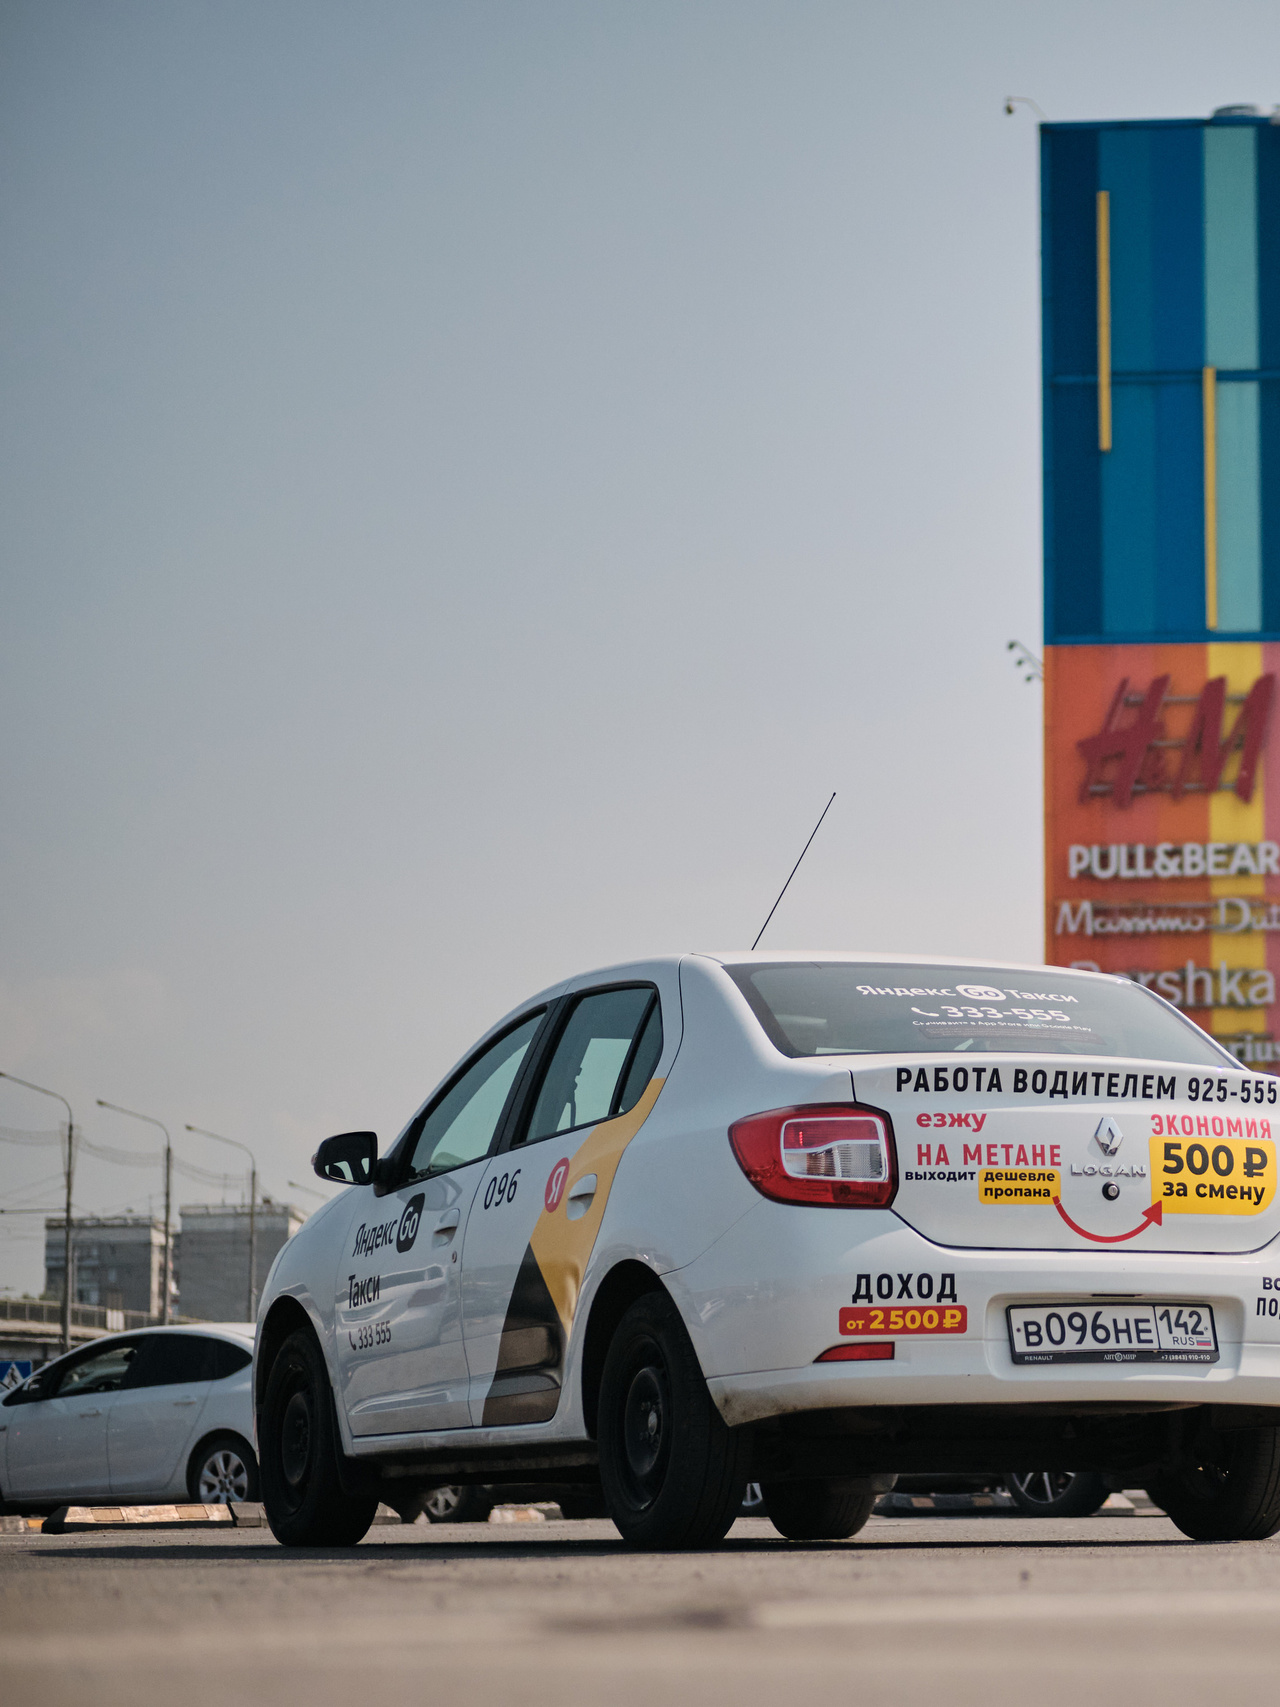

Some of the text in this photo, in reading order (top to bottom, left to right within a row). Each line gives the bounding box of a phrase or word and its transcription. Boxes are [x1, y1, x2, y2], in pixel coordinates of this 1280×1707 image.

[1069, 841, 1280, 879] PULL&BEAR
[1056, 899, 1205, 936] Massimo
[856, 985, 956, 997] Яндекс
[1005, 989, 1079, 1003] Такси
[940, 1005, 1071, 1022] 333-555
[896, 1067, 1278, 1104] РАБОТА ВОДИТЕЛЕМ 925-555
[916, 1112, 987, 1133] езжу
[1151, 1114, 1272, 1139] ЭКОНОМИЯ
[917, 1144, 1062, 1166] НА МЕТАНЕ
[1163, 1142, 1234, 1177] 500
[905, 1171, 1055, 1182] выходит дешевле
[1070, 1163, 1147, 1177] LOGAN
[484, 1169, 521, 1210] 096
[546, 1165, 567, 1204] Я
[984, 1186, 1051, 1199] пропана
[1163, 1182, 1265, 1205] за смену
[352, 1219, 398, 1257] Яндекс
[348, 1274, 380, 1309] Такси
[852, 1273, 957, 1304] ДОХОД
[358, 1320, 392, 1350] 333 555
[846, 1320, 865, 1330] от
[1023, 1309, 1205, 1346] В096НЕ 142
[1172, 1336, 1195, 1346] RUS
